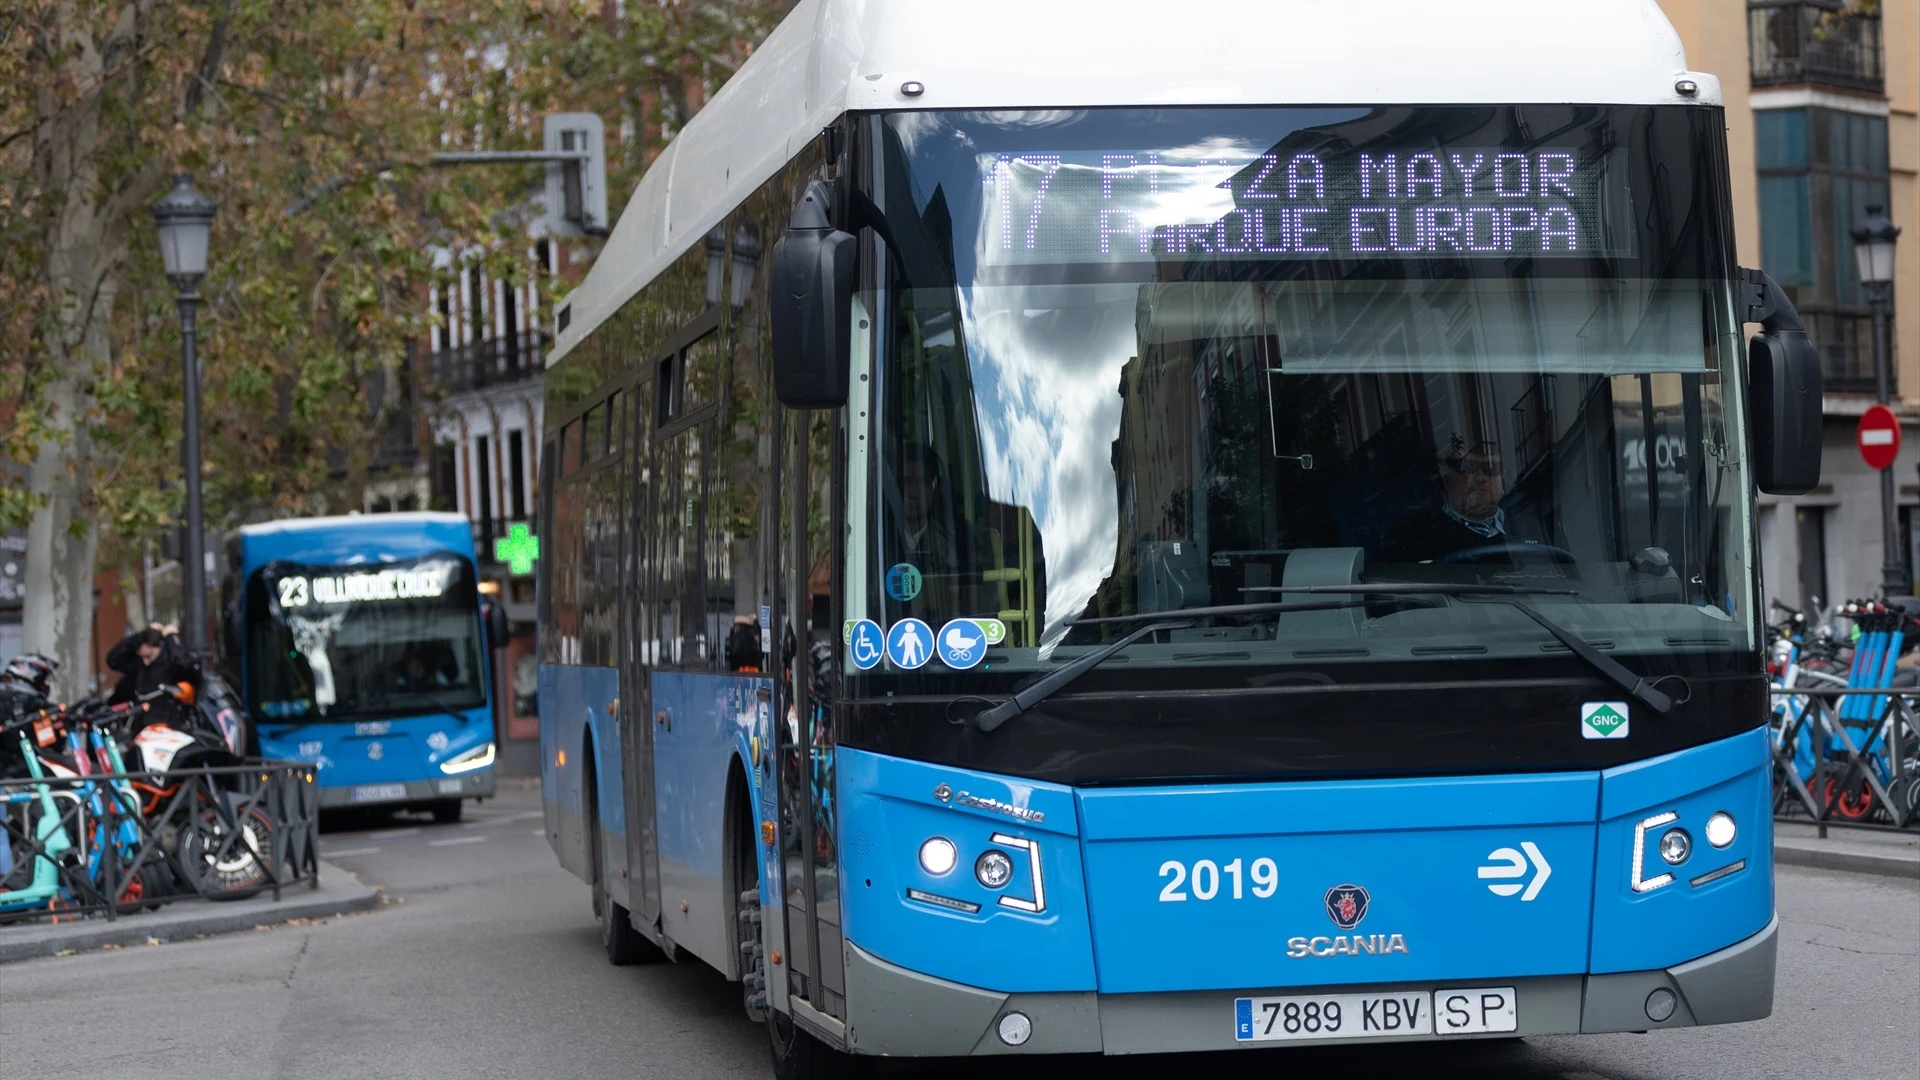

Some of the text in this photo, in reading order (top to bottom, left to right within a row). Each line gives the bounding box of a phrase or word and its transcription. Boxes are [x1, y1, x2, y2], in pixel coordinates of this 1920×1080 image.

[1361, 153, 1575, 198] MAYOR
[982, 154, 1060, 249] 17
[1351, 207, 1577, 251] EUROPA
[279, 576, 308, 607] 23
[988, 622, 999, 637] 3
[1592, 715, 1619, 726] GNC
[956, 791, 1045, 822] Castrosua
[1158, 857, 1279, 901] 2019
[1286, 934, 1409, 958] SCANIA
[1241, 1024, 1249, 1033] E
[1262, 998, 1420, 1035] 7889 KBV
